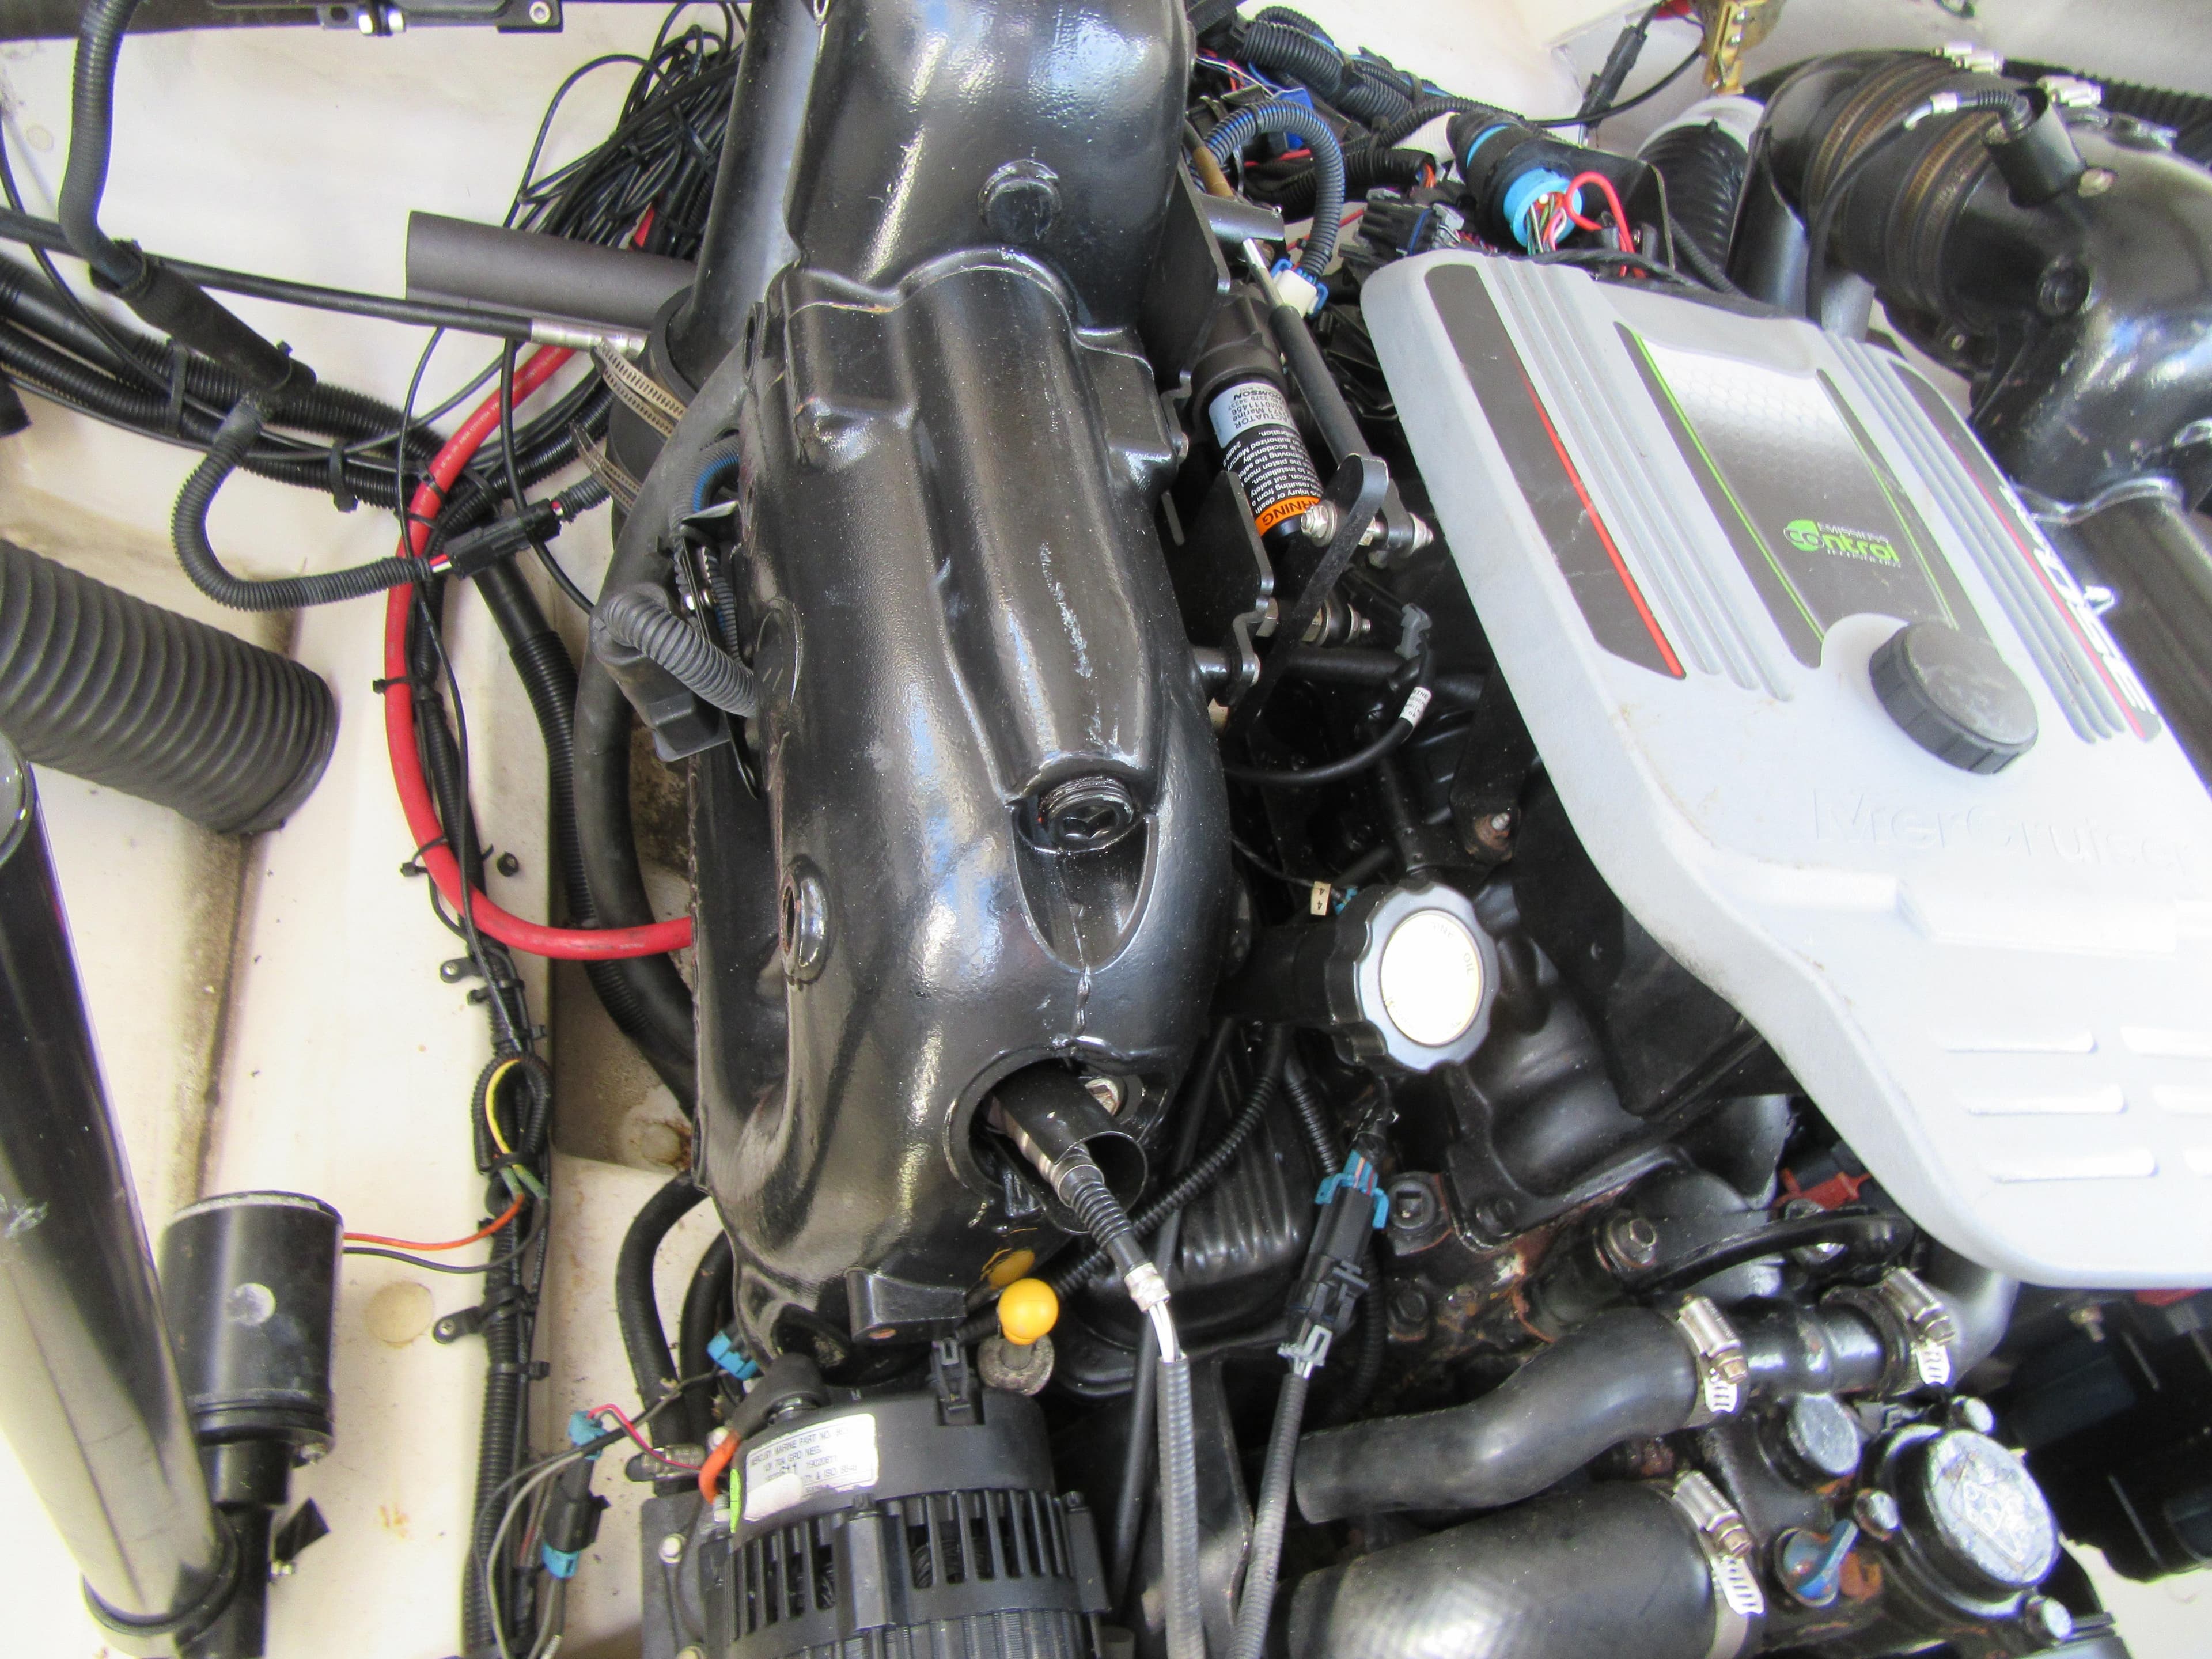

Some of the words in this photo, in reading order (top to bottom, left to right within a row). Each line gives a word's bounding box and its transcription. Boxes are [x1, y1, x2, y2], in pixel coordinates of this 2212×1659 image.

[1233, 407, 1264, 421] Marine
[1234, 413, 1287, 429] ACTUATOR
[1227, 447, 1250, 472] Mercury
[1243, 445, 1288, 464] accidentally
[1255, 455, 1268, 464] the
[1238, 463, 1253, 479] safet
[1262, 458, 1288, 469] piston
[1244, 467, 1262, 483] more
[1252, 467, 1296, 484] installation.
[1274, 475, 1287, 483] cut
[1251, 480, 1272, 498] safety
[1275, 482, 1310, 491] resulting
[1257, 488, 1274, 502] from
[1255, 497, 1275, 514] death
